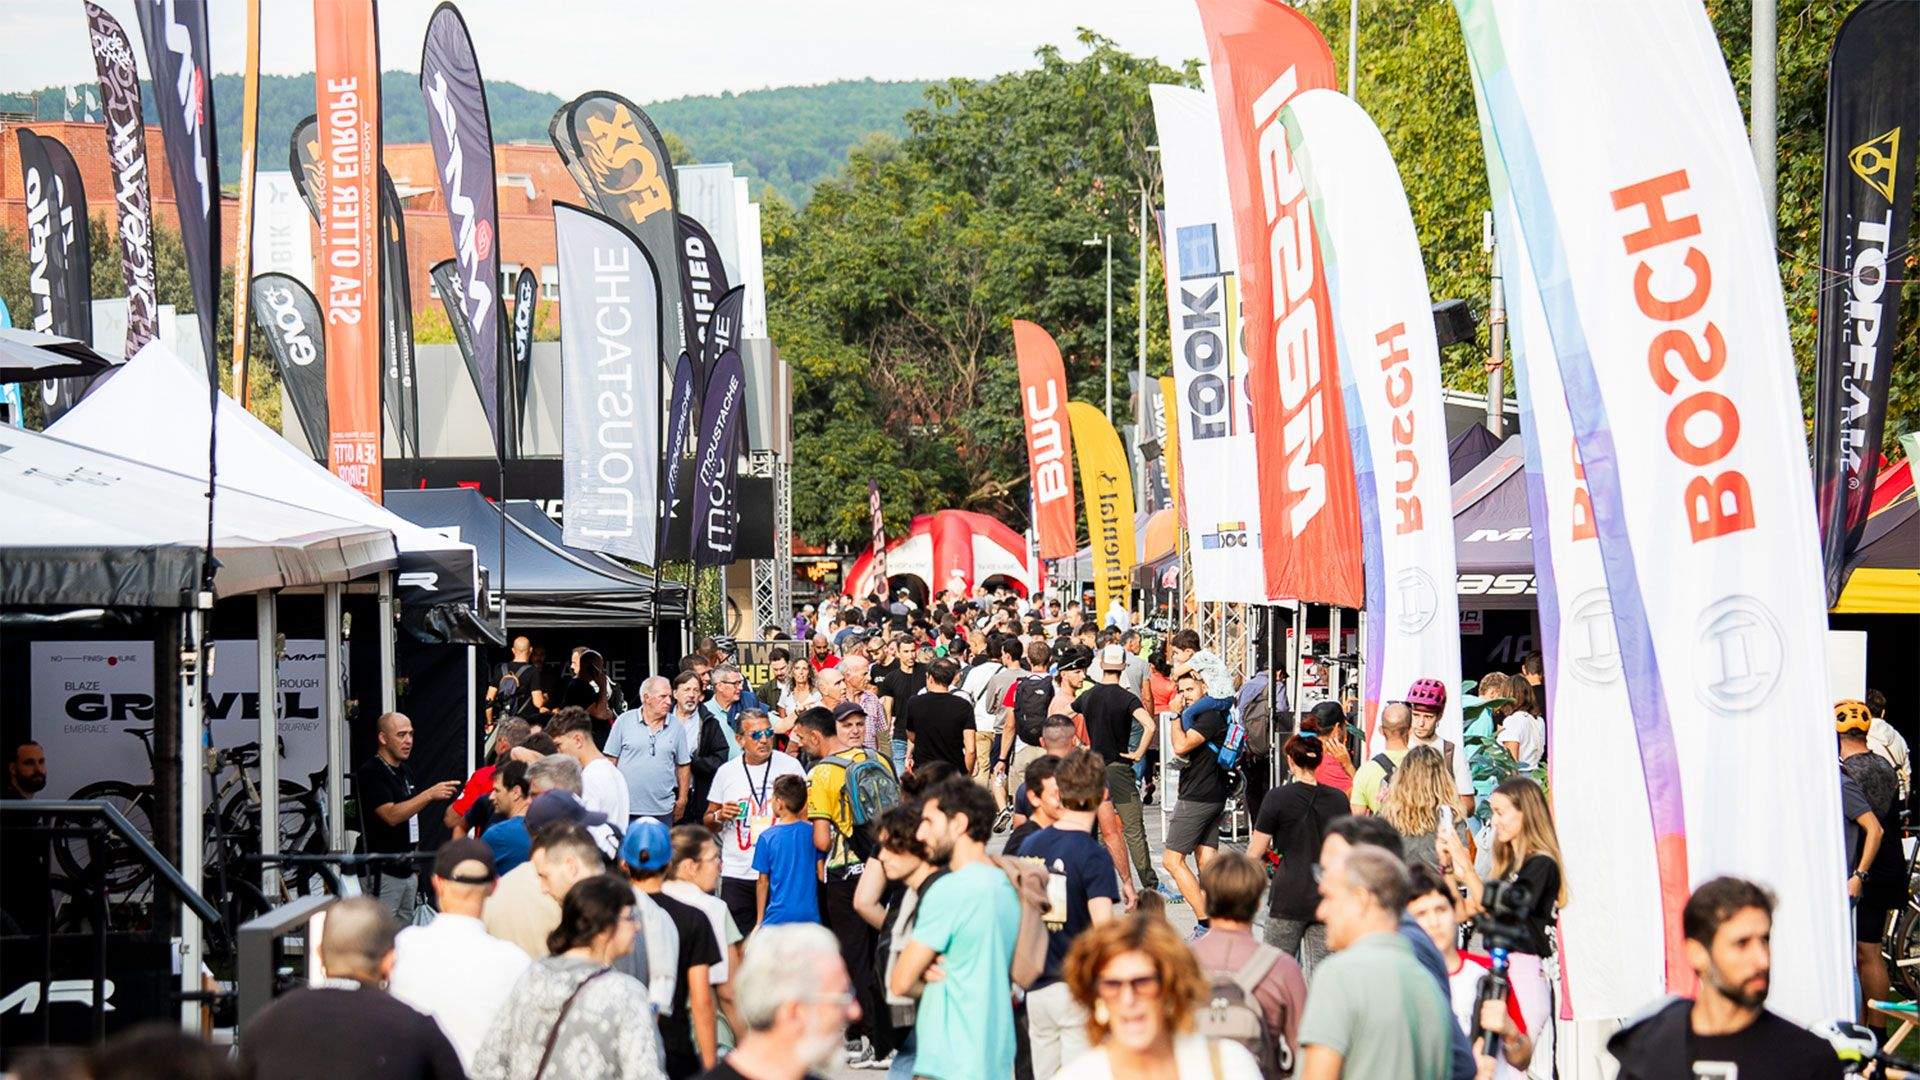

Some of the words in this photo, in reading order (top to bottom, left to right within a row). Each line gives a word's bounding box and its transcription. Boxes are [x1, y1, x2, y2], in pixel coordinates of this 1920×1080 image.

[1850, 209, 1892, 475] TOPEAK
[700, 374, 739, 488] MOUSTACHE
[64, 681, 100, 691] BLAZE
[278, 678, 320, 689] ROUGH
[65, 691, 320, 721] GRVEL
[64, 723, 109, 734] EMBRACE
